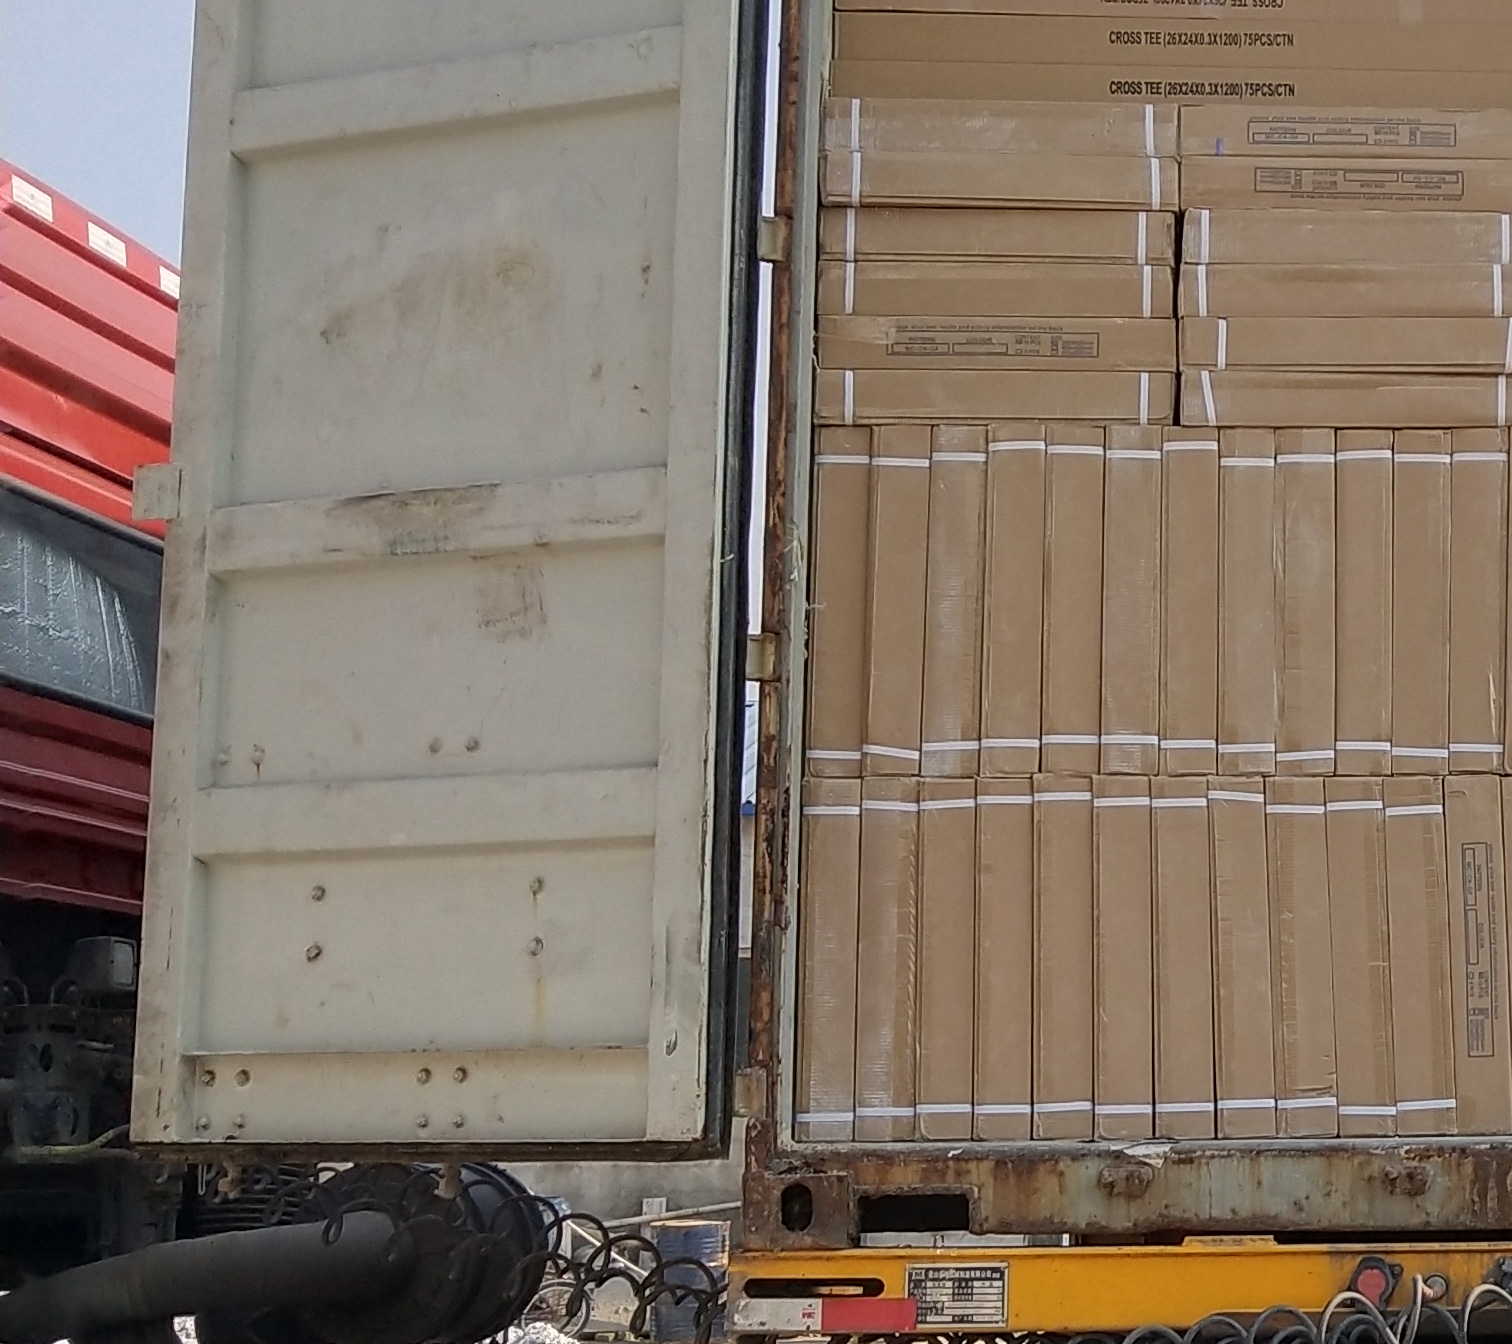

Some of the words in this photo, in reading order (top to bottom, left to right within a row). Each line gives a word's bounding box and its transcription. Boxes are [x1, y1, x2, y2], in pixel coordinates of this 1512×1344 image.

[1109, 30, 1142, 45] CROSS
[1144, 31, 1162, 45] TEE
[1109, 80, 1142, 95] CROSS
[1144, 81, 1162, 95] TEE
